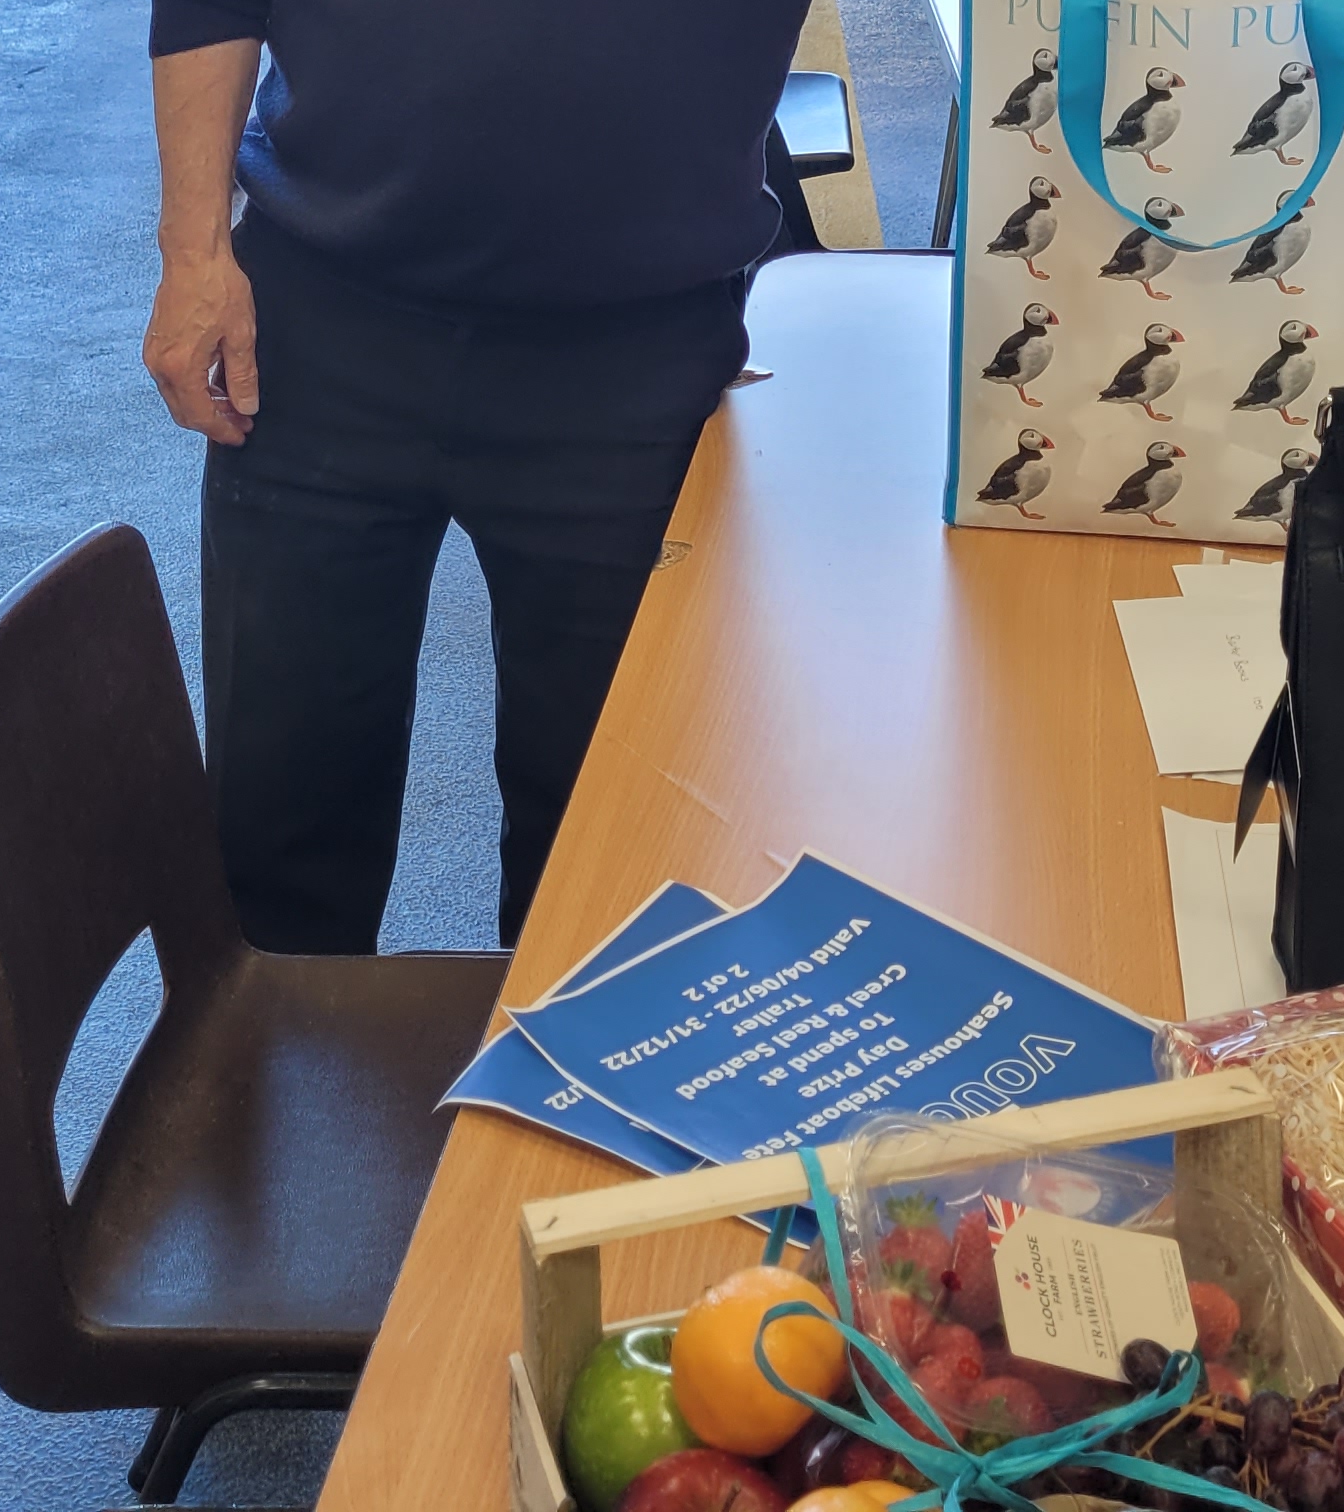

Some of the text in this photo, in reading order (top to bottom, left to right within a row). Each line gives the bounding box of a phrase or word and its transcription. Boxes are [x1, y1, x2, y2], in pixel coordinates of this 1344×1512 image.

[810, 918, 872, 965] Valid
[681, 963, 750, 1002] 2 of 2
[714, 960, 815, 1015] 04/06/22
[675, 963, 907, 1101] Creel & Reel Seafood
[732, 993, 813, 1037] Trailer
[599, 1016, 707, 1071] 31/12/22
[758, 1011, 896, 1087] To spend at
[798, 1036, 909, 1099] Day Prize
[741, 990, 1014, 1161] Seahouses Lifeboat Fete
[1028, 1234, 1057, 1339] CLOCK HOUSE
[1050, 1274, 1064, 1305] FARM
[1067, 1270, 1084, 1317] ENGLISH
[1072, 1238, 1108, 1360] STRAWBERRIES
